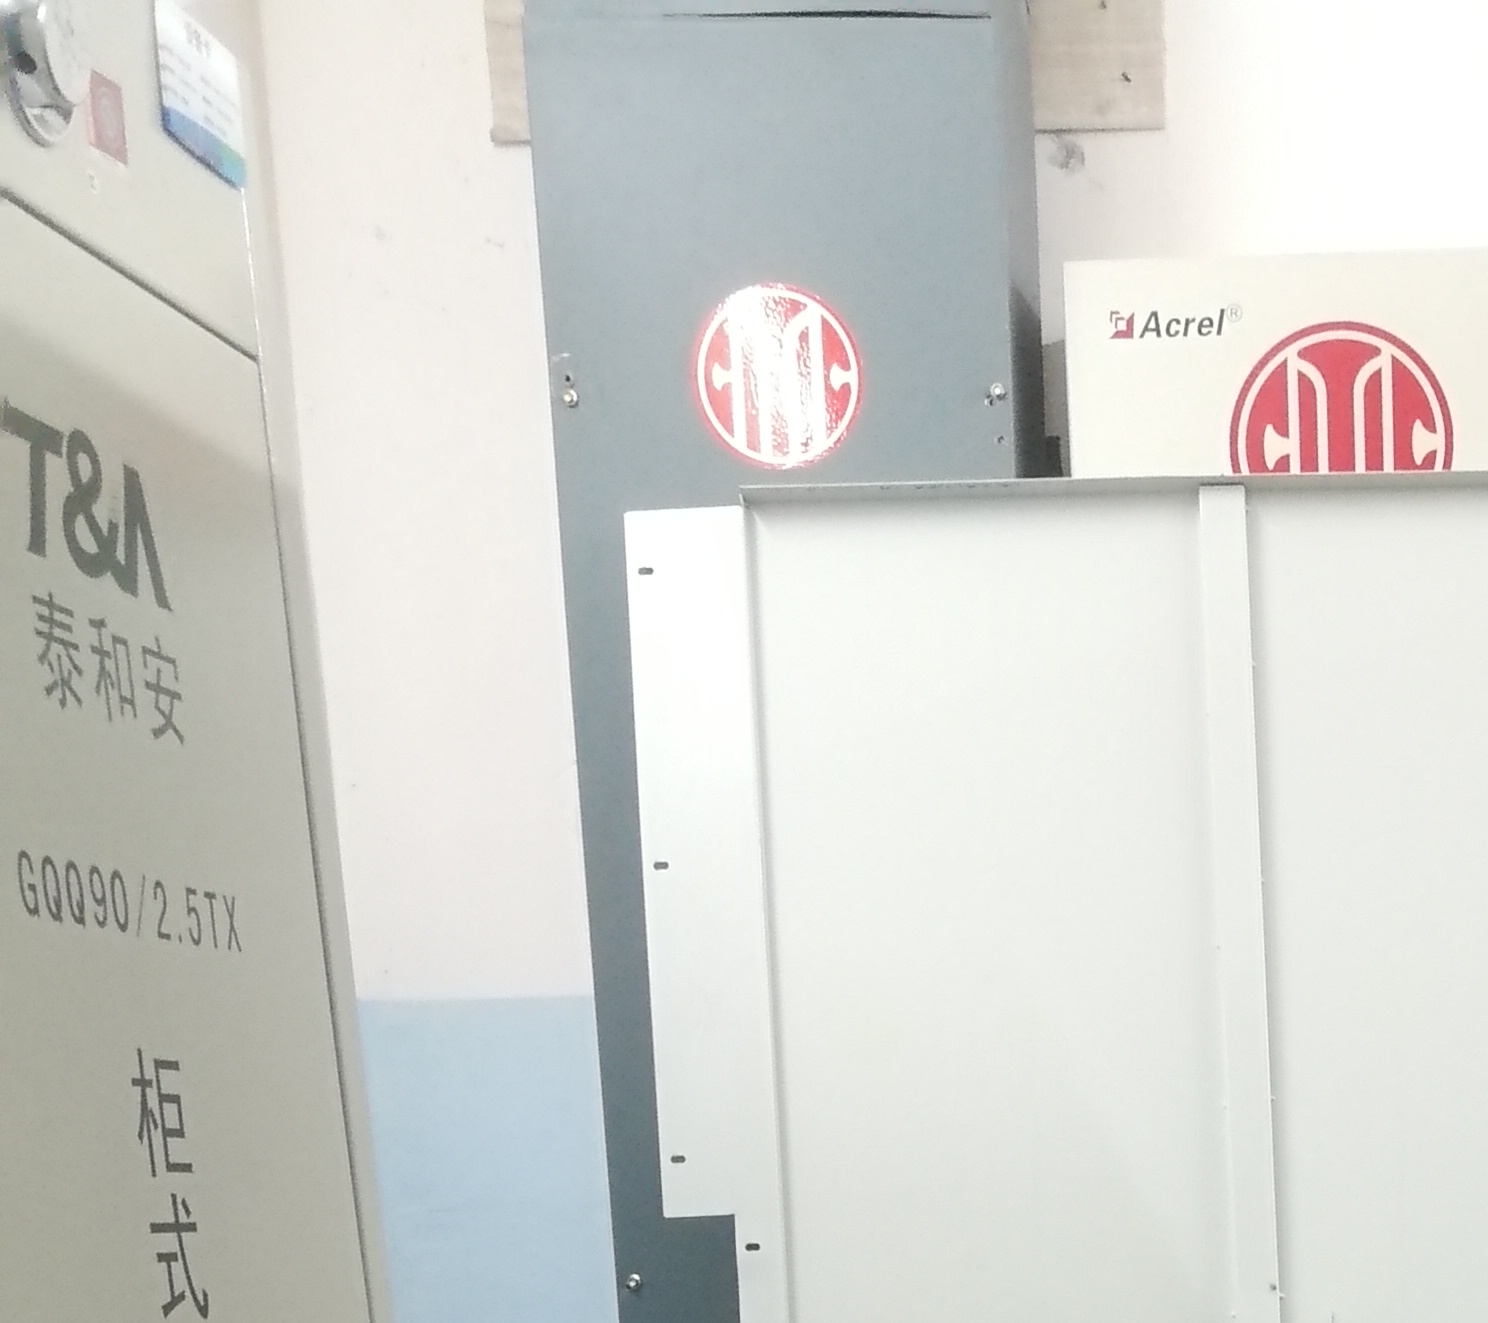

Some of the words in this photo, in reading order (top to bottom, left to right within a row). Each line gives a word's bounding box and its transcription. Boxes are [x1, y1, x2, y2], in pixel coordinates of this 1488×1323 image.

[31, 592, 187, 746] 泰和安
[16, 849, 242, 953] GQQ90/2.5TX
